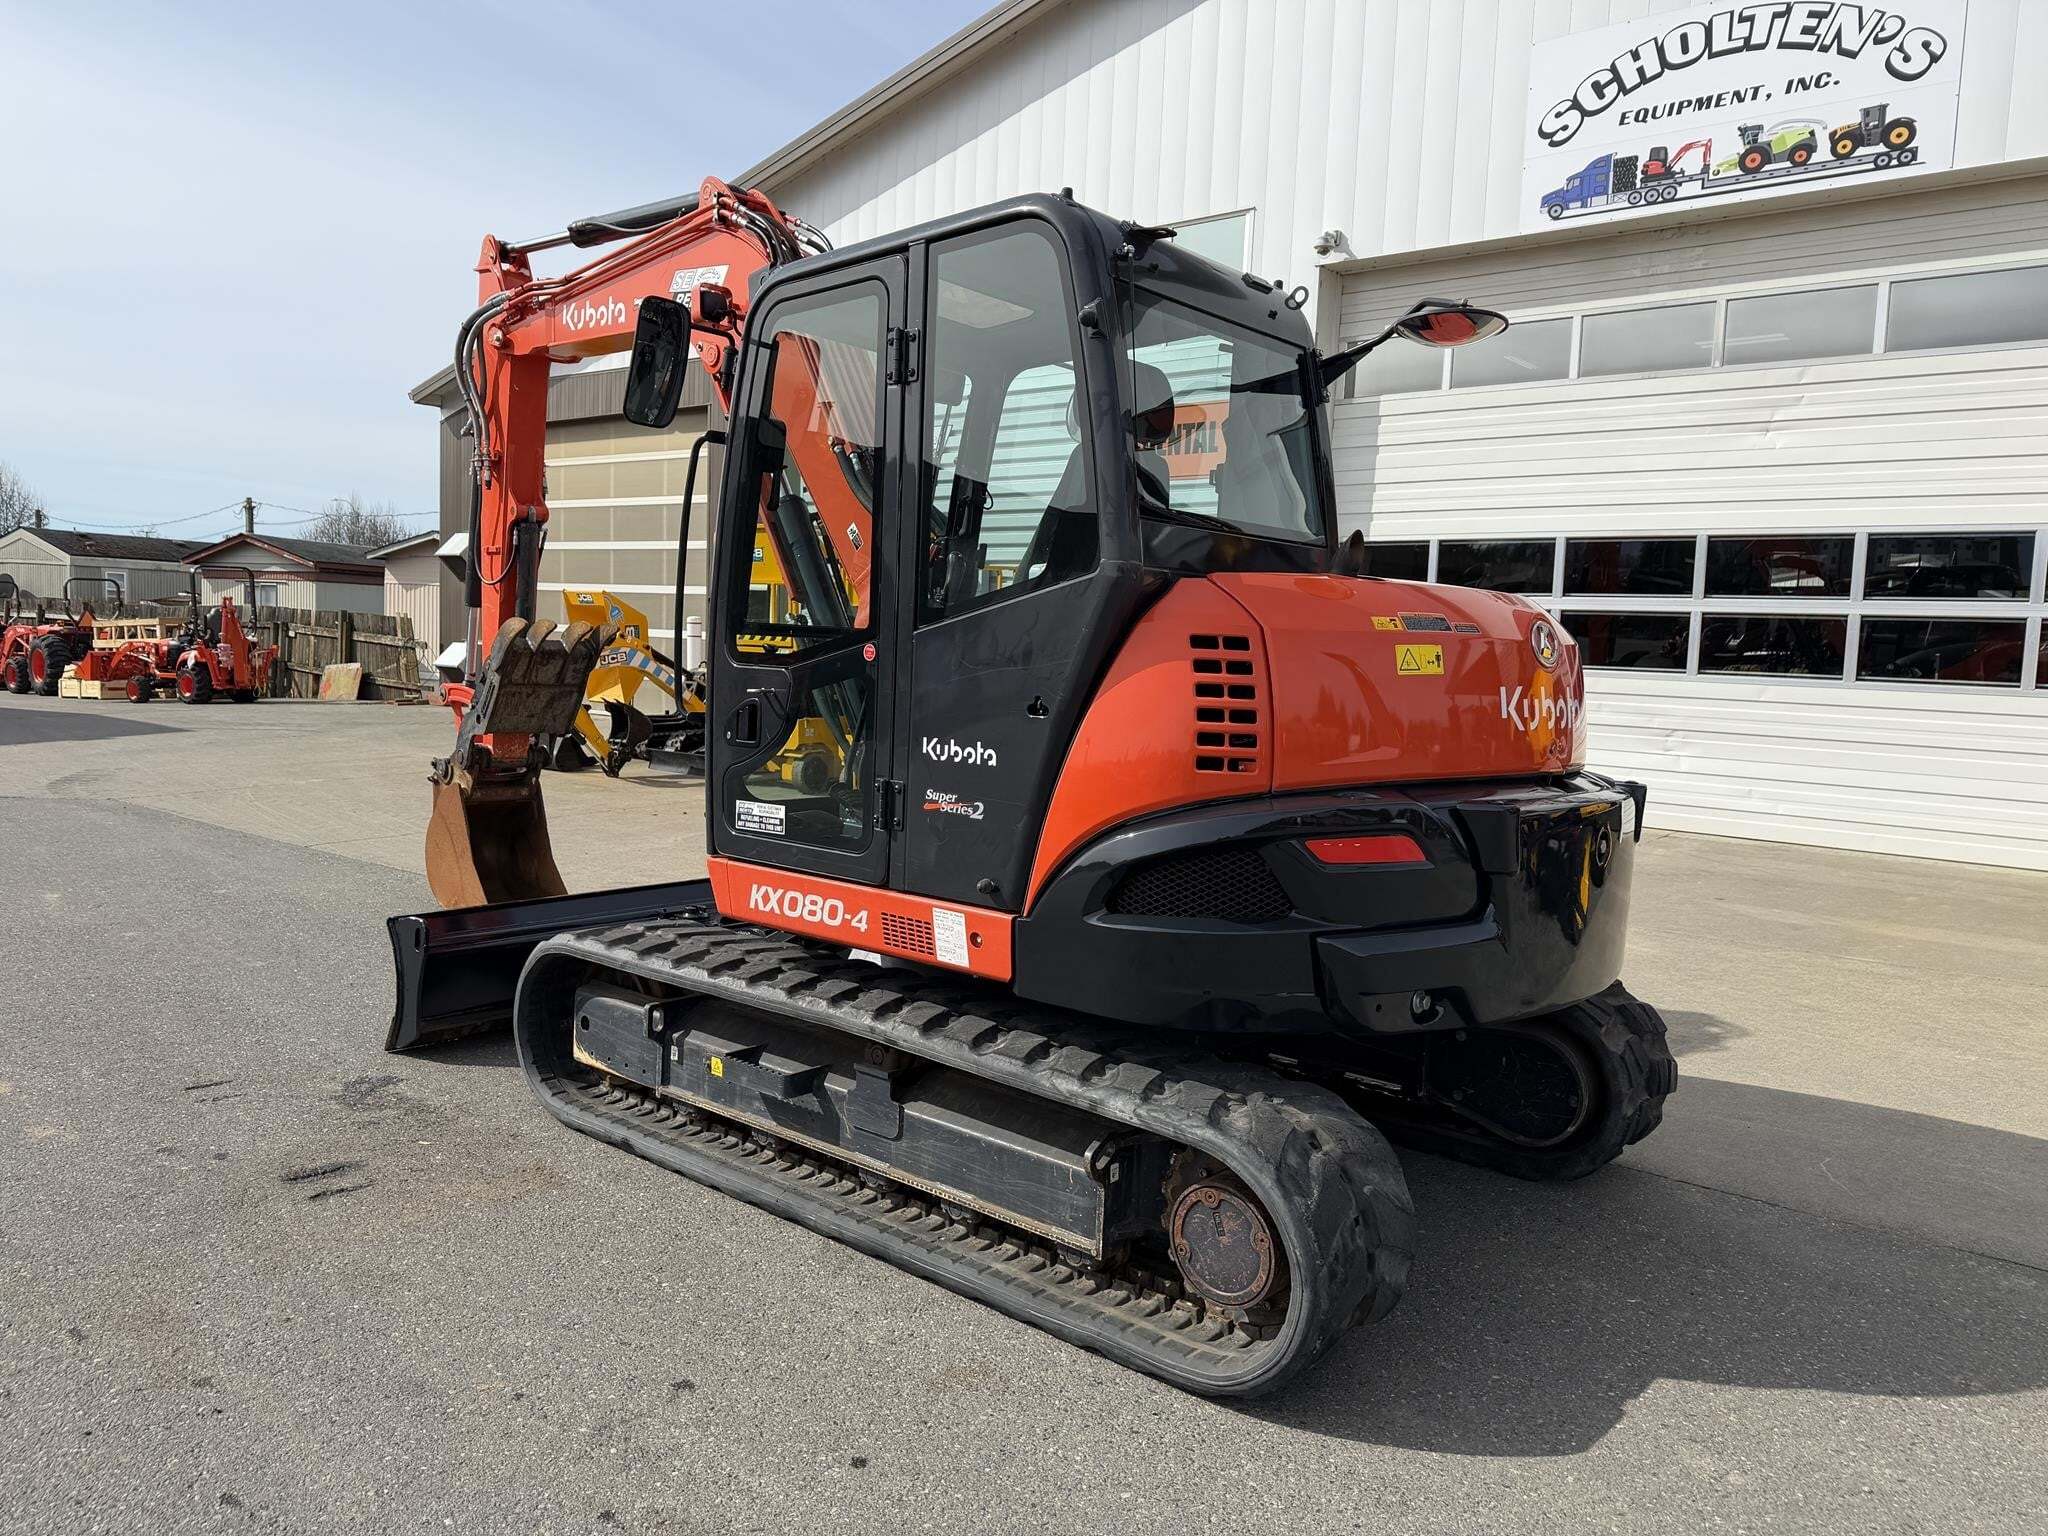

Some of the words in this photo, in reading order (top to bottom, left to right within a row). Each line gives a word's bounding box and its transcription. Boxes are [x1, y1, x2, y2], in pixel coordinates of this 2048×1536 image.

[1538, 1, 1947, 147] SCHOLTEN'S
[1618, 84, 1772, 126] EQUIPMENT,
[1785, 71, 1840, 95] INC.
[563, 295, 626, 331] Kubota
[601, 653, 627, 665] JCB
[1500, 686, 1580, 731] Kubota
[922, 736, 997, 767] Kubota
[925, 788, 957, 803] Super
[749, 884, 868, 932] KX080-4
